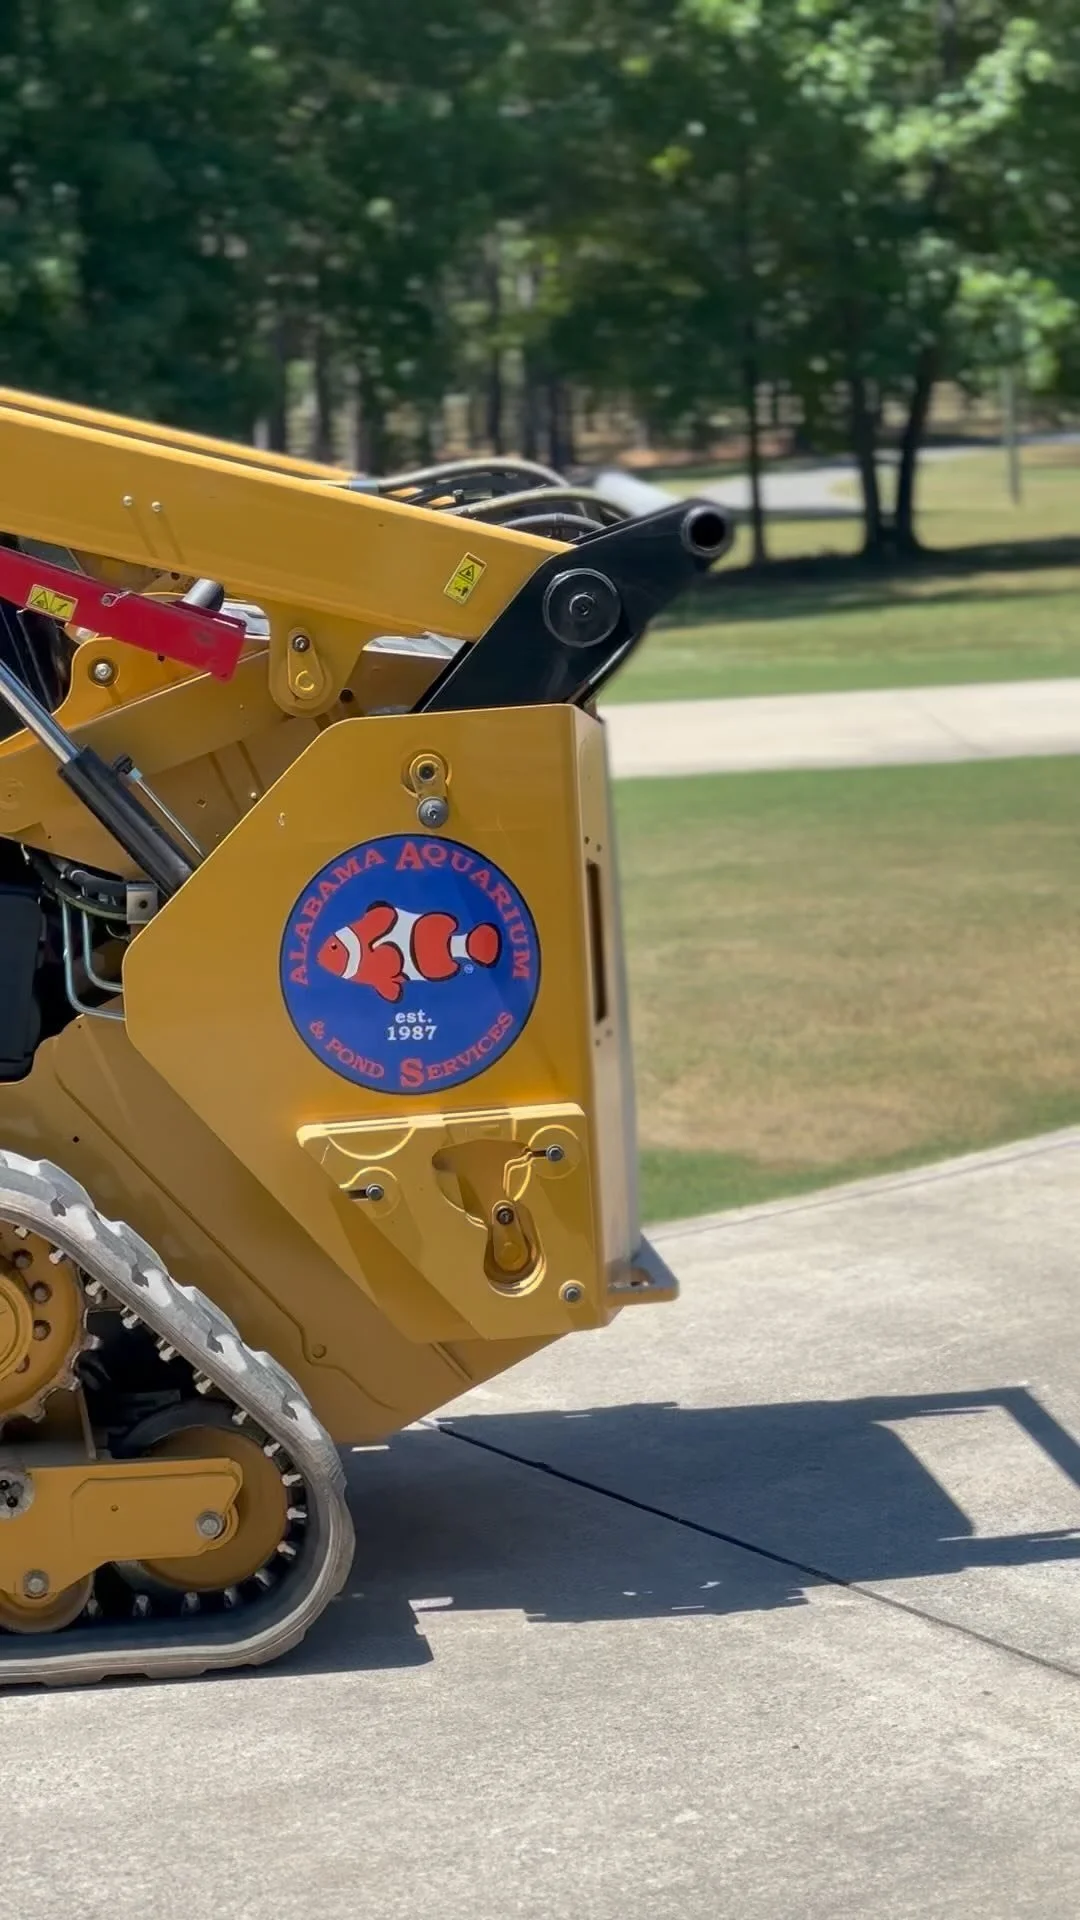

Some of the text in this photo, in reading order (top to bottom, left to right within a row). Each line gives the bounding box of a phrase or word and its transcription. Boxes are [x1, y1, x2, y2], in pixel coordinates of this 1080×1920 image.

[291, 841, 531, 985] ALABAMA AQUARIUM
[387, 1026, 437, 1041] 1987
[395, 1009, 433, 1024] est.
[309, 1011, 515, 1088] & POND SERVICES
